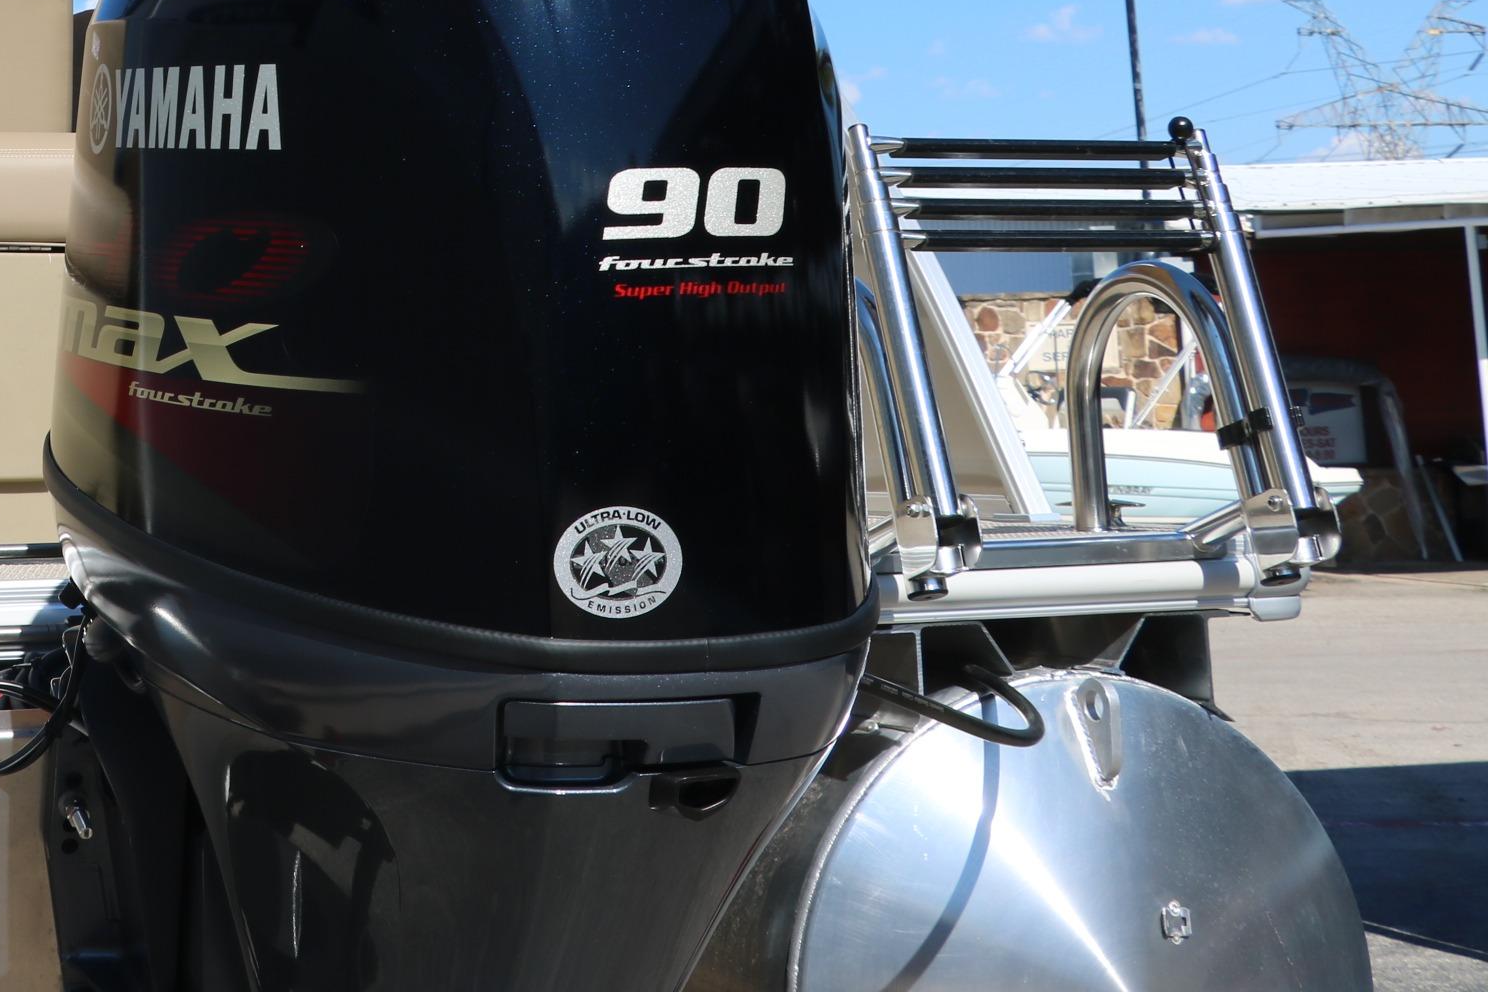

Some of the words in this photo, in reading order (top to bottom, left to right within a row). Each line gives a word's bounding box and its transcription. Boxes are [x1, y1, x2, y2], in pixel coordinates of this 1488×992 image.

[114, 63, 282, 151] YAMAHA
[602, 167, 786, 240] 90
[614, 283, 673, 300] Super
[679, 281, 722, 298] High
[727, 280, 786, 296] Output
[587, 596, 657, 615] EMISSION
